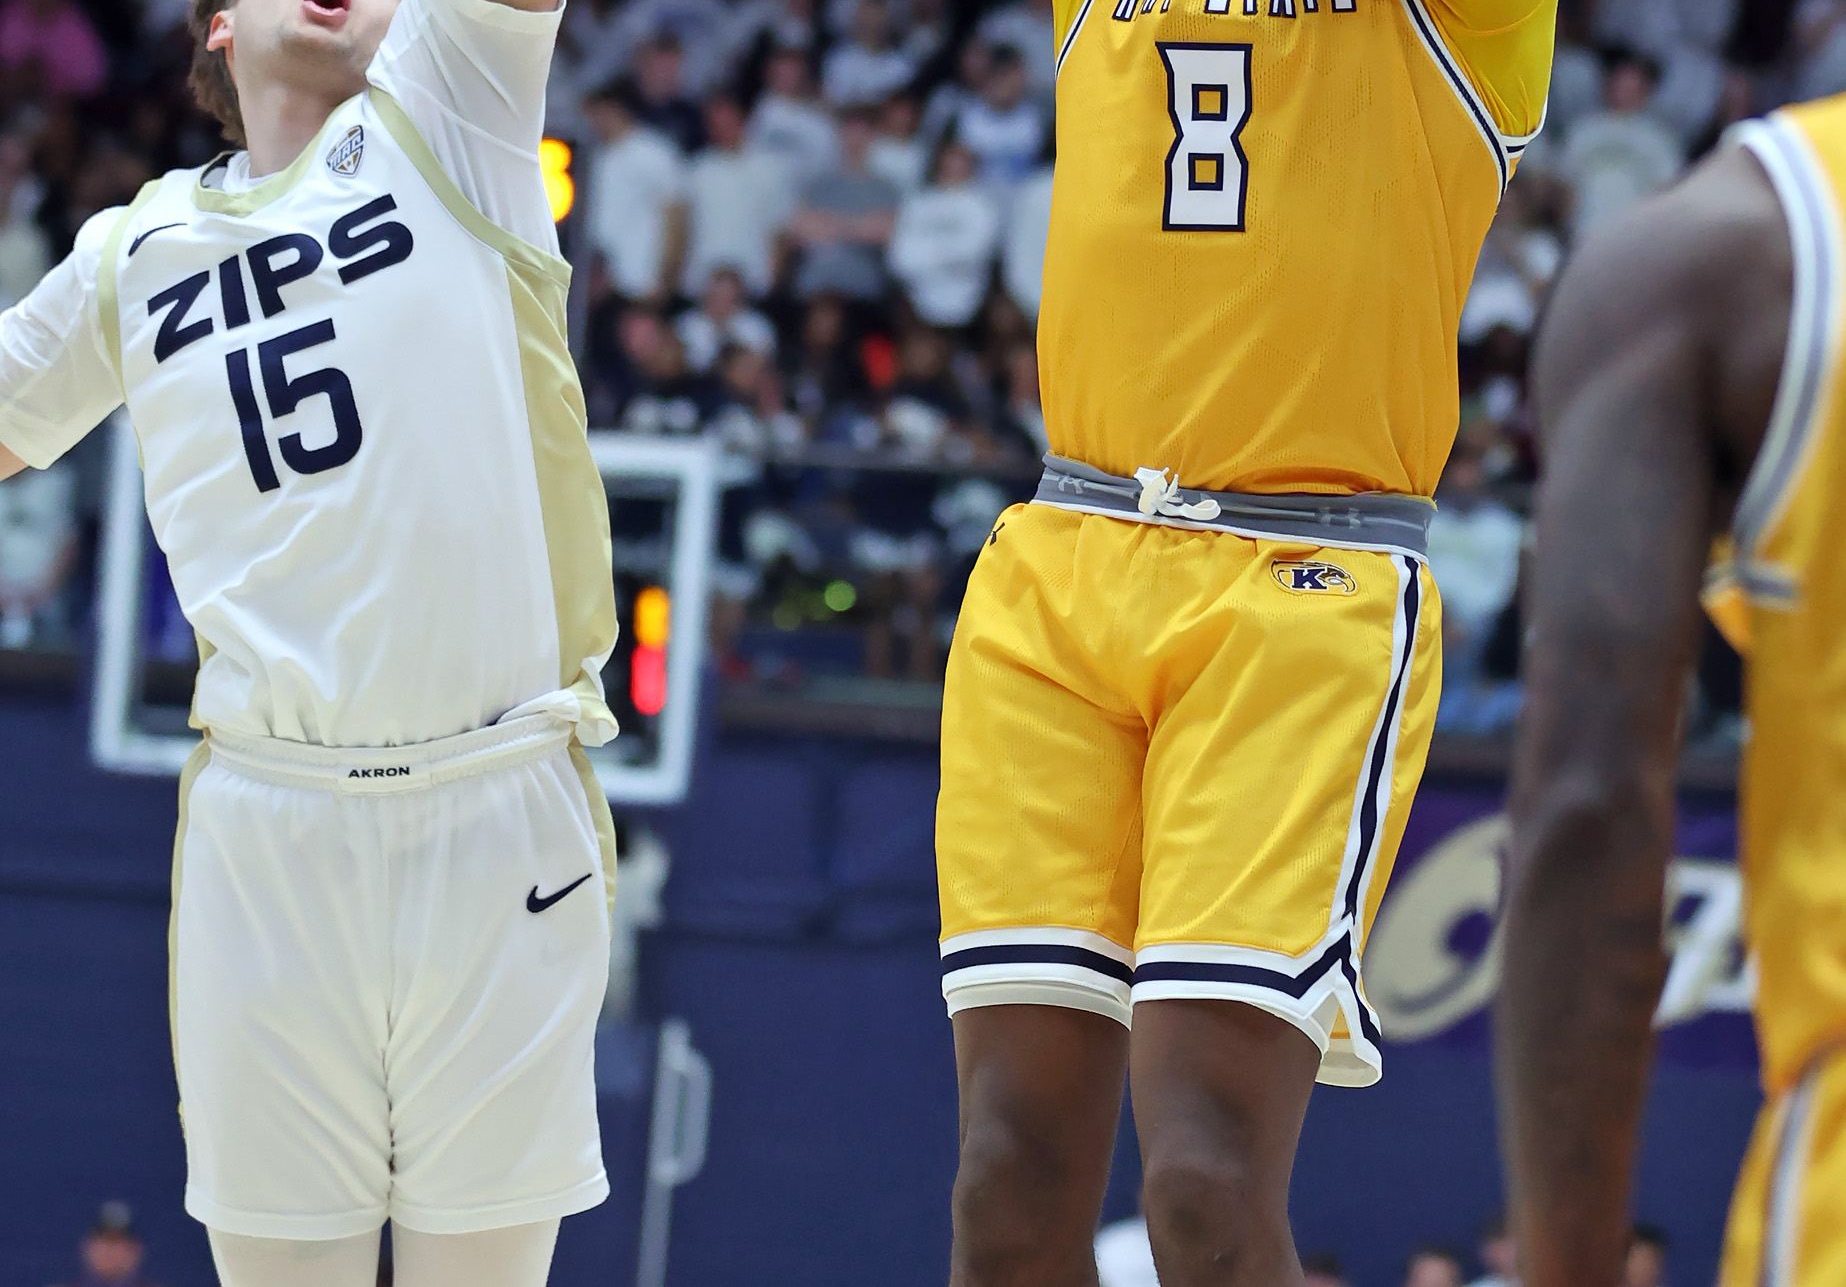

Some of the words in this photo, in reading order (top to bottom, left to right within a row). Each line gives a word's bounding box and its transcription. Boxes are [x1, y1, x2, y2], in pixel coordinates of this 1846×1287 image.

[1155, 41, 1252, 232] 8
[147, 193, 413, 364] ZIPS
[225, 318, 362, 493] 15
[1291, 568, 1328, 590] K
[348, 766, 410, 778] AKRON
